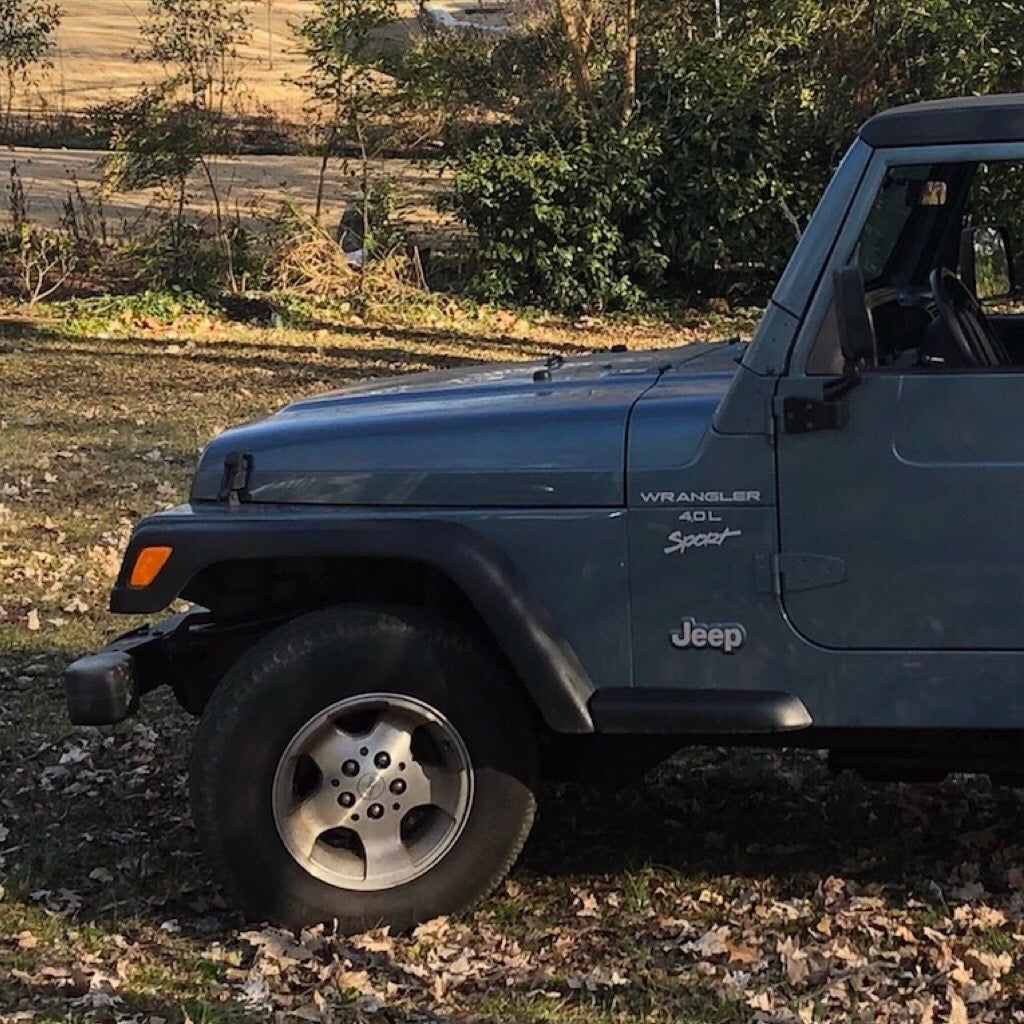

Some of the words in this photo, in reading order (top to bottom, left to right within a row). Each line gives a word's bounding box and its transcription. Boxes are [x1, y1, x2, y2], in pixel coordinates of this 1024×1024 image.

[640, 491, 761, 502] WRANGLER
[664, 528, 741, 554] Sport
[672, 621, 742, 651] Jeep
